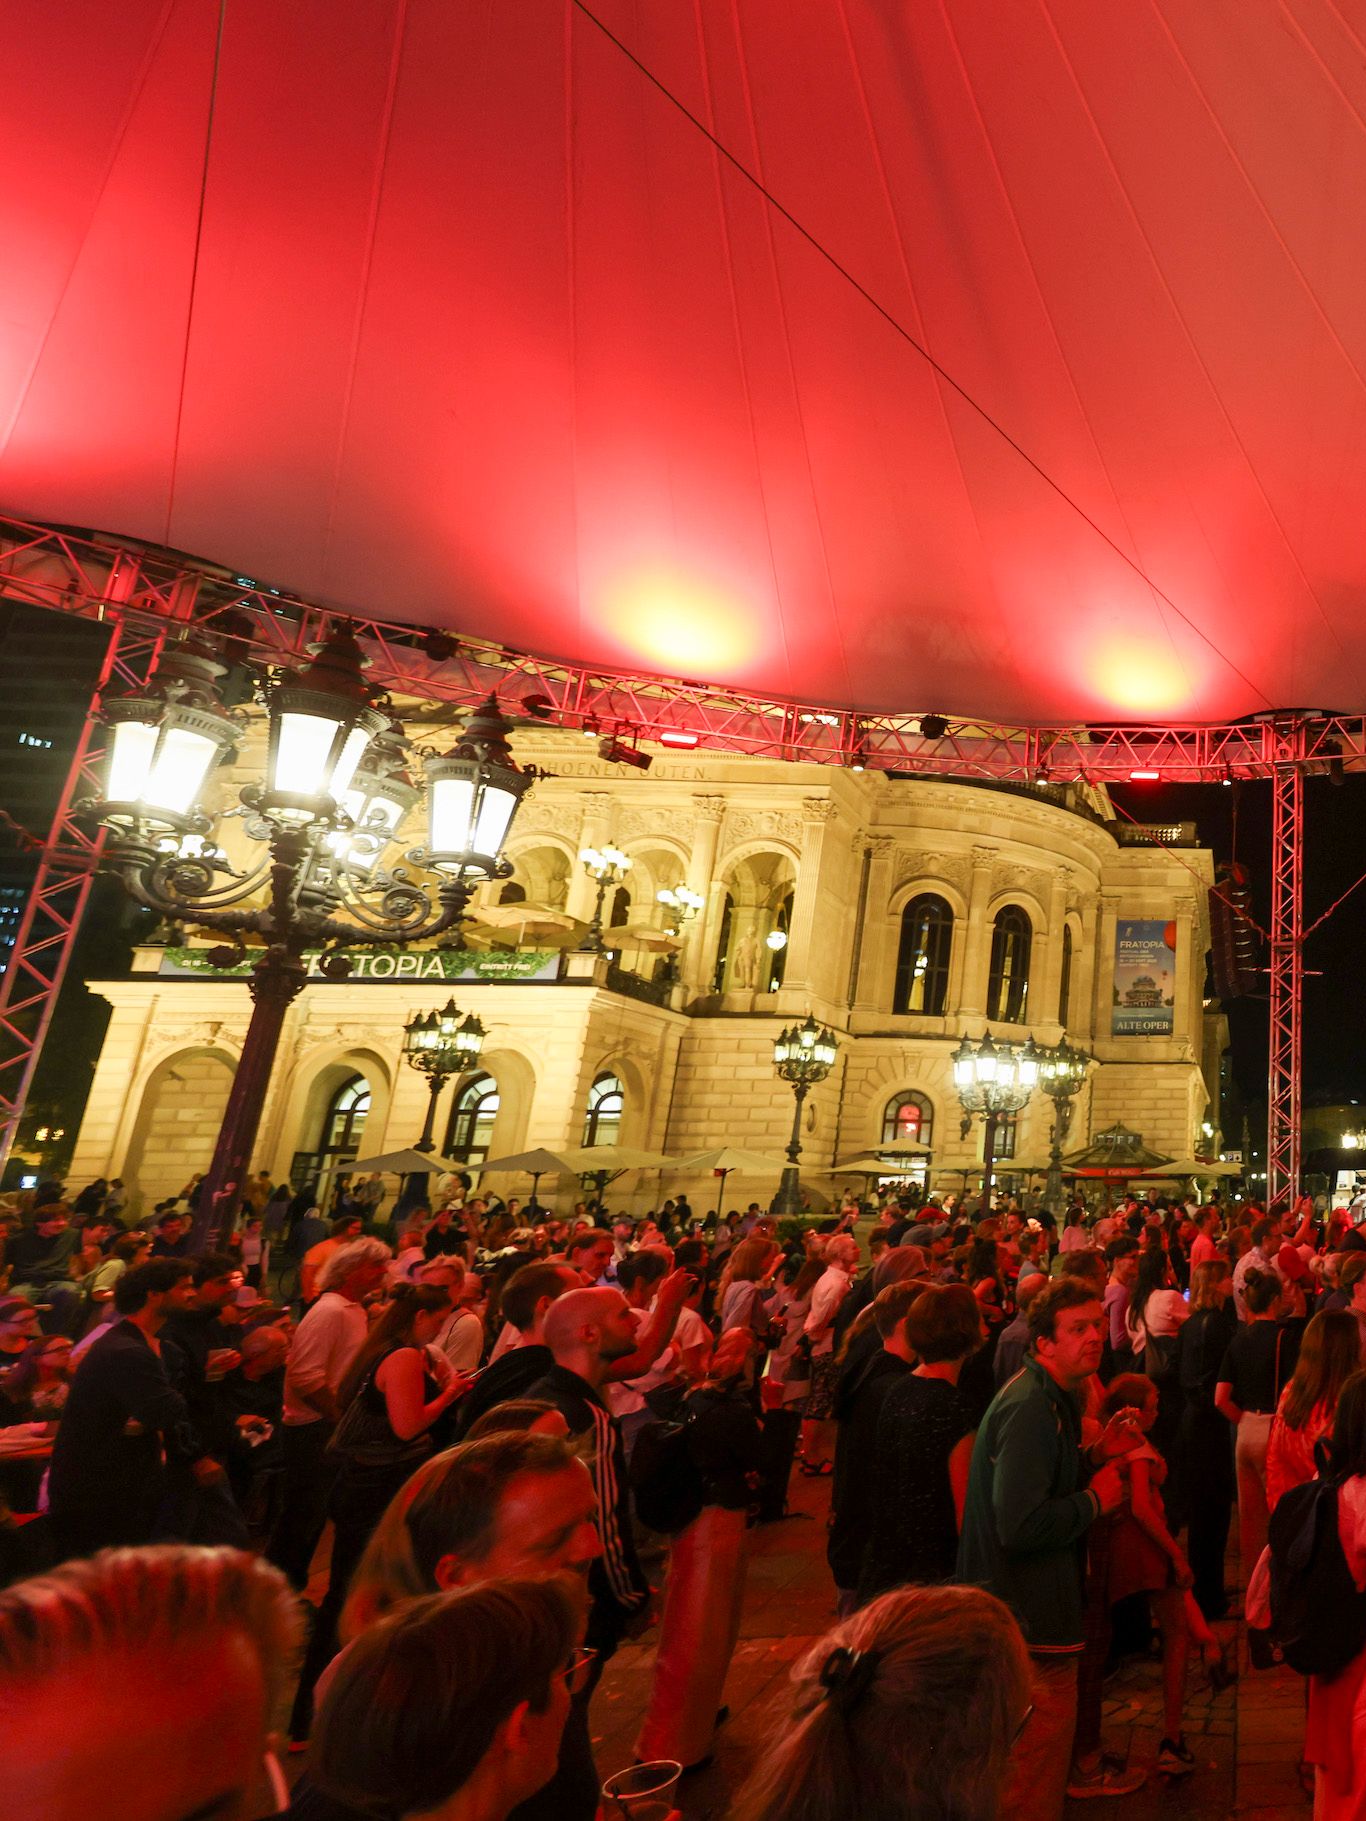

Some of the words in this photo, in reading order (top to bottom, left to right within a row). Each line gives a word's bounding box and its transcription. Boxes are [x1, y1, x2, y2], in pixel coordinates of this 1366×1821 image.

[1120, 941, 1165, 949] FRATOPIA
[300, 954, 446, 978] RTOPIA
[1117, 1021, 1142, 1030] ALTE
[1143, 1021, 1169, 1030] OPER
